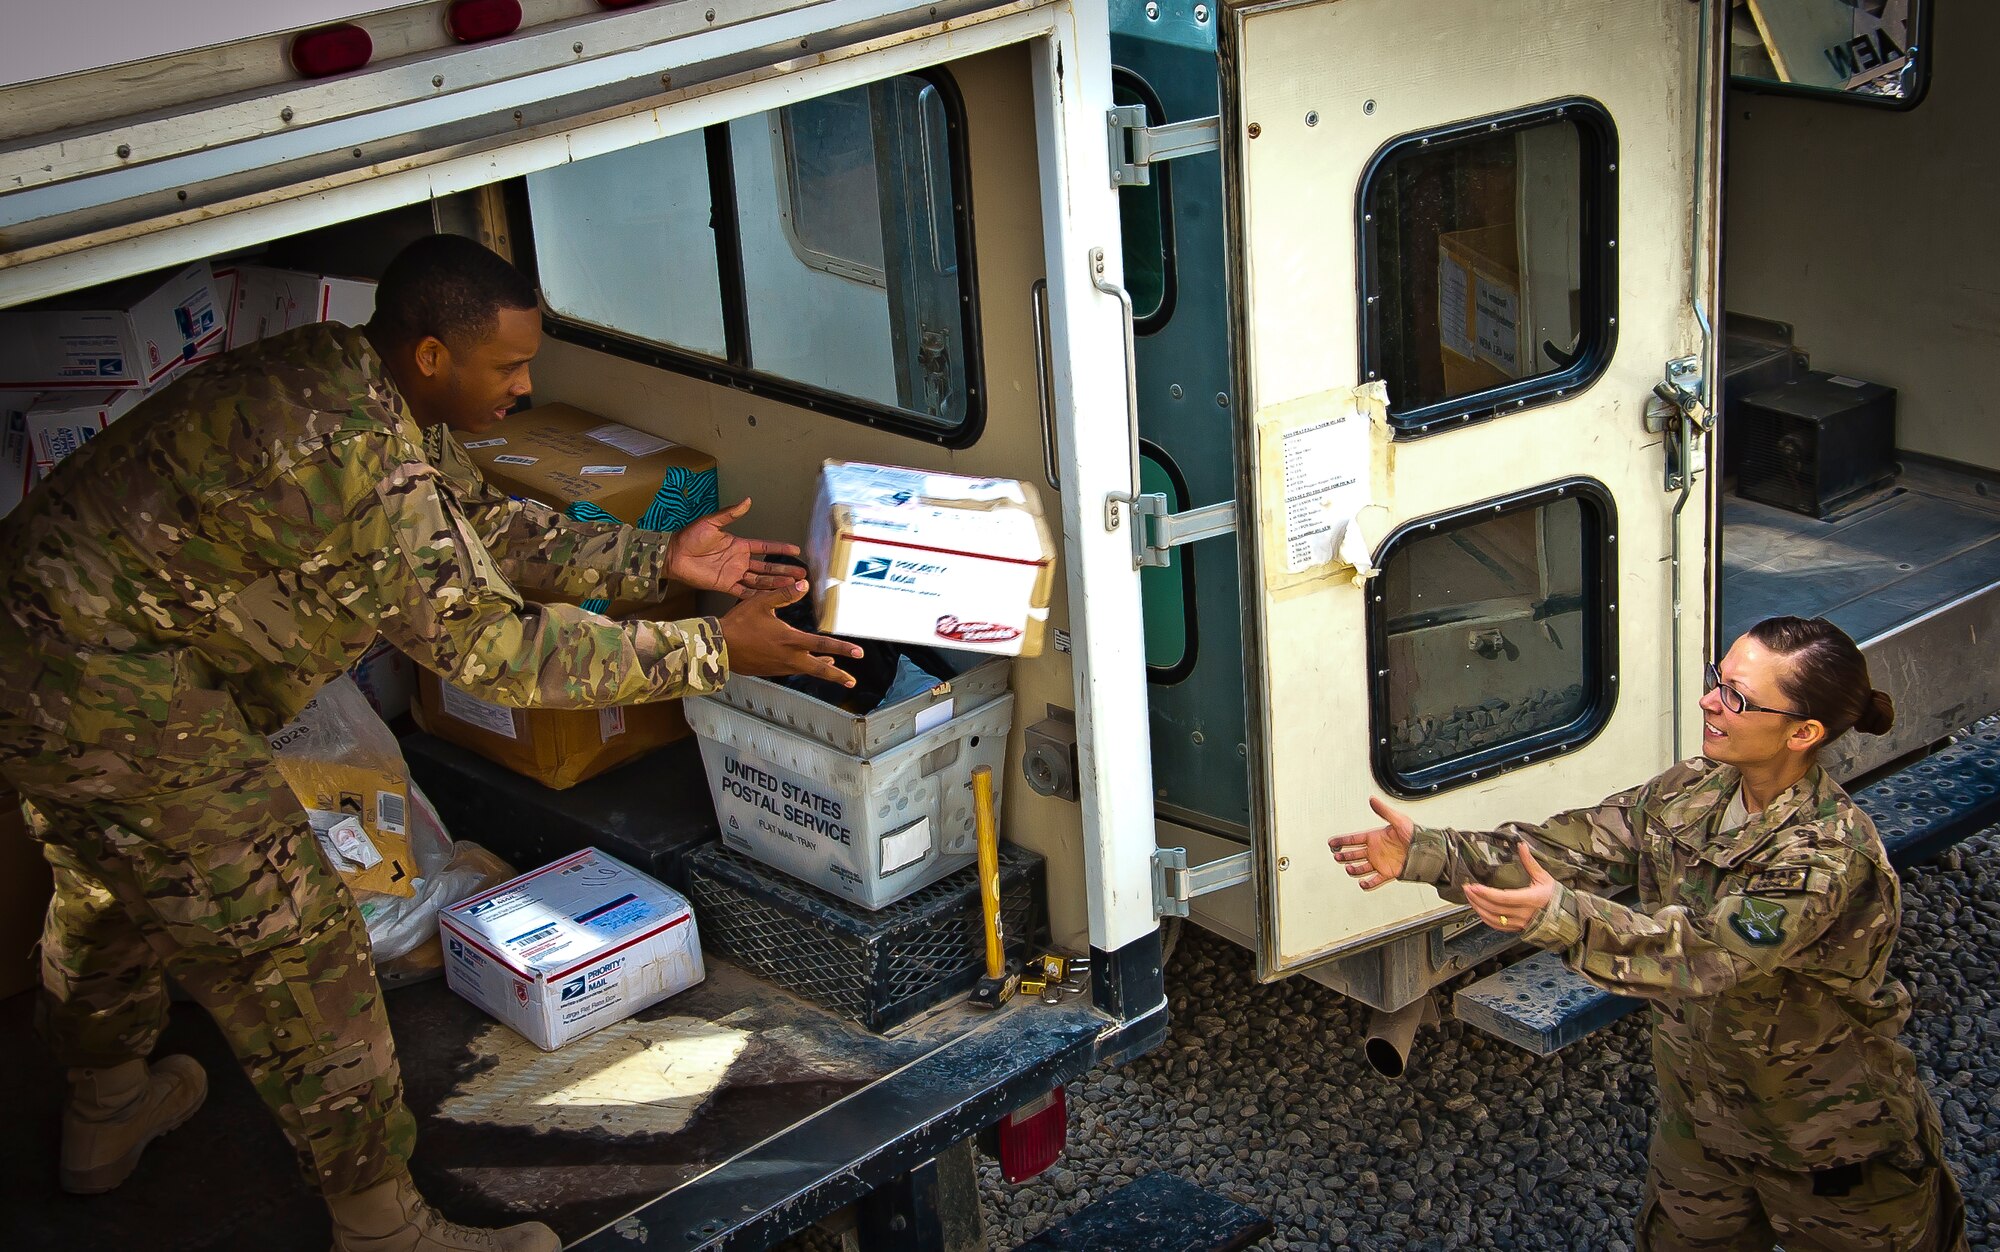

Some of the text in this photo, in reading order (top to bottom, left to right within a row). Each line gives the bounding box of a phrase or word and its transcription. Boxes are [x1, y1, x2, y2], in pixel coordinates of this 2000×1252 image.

[724, 756, 842, 820] UNITED STATES
[722, 776, 780, 816] POSTAL
[784, 804, 851, 847] SERVICE
[758, 820, 817, 851] FLAT MAIL TRAY
[587, 958, 621, 980] PRIORITY
[588, 978, 608, 992] MAIL
[562, 1010, 580, 1020] Large
[580, 1003, 590, 1014] Flat
